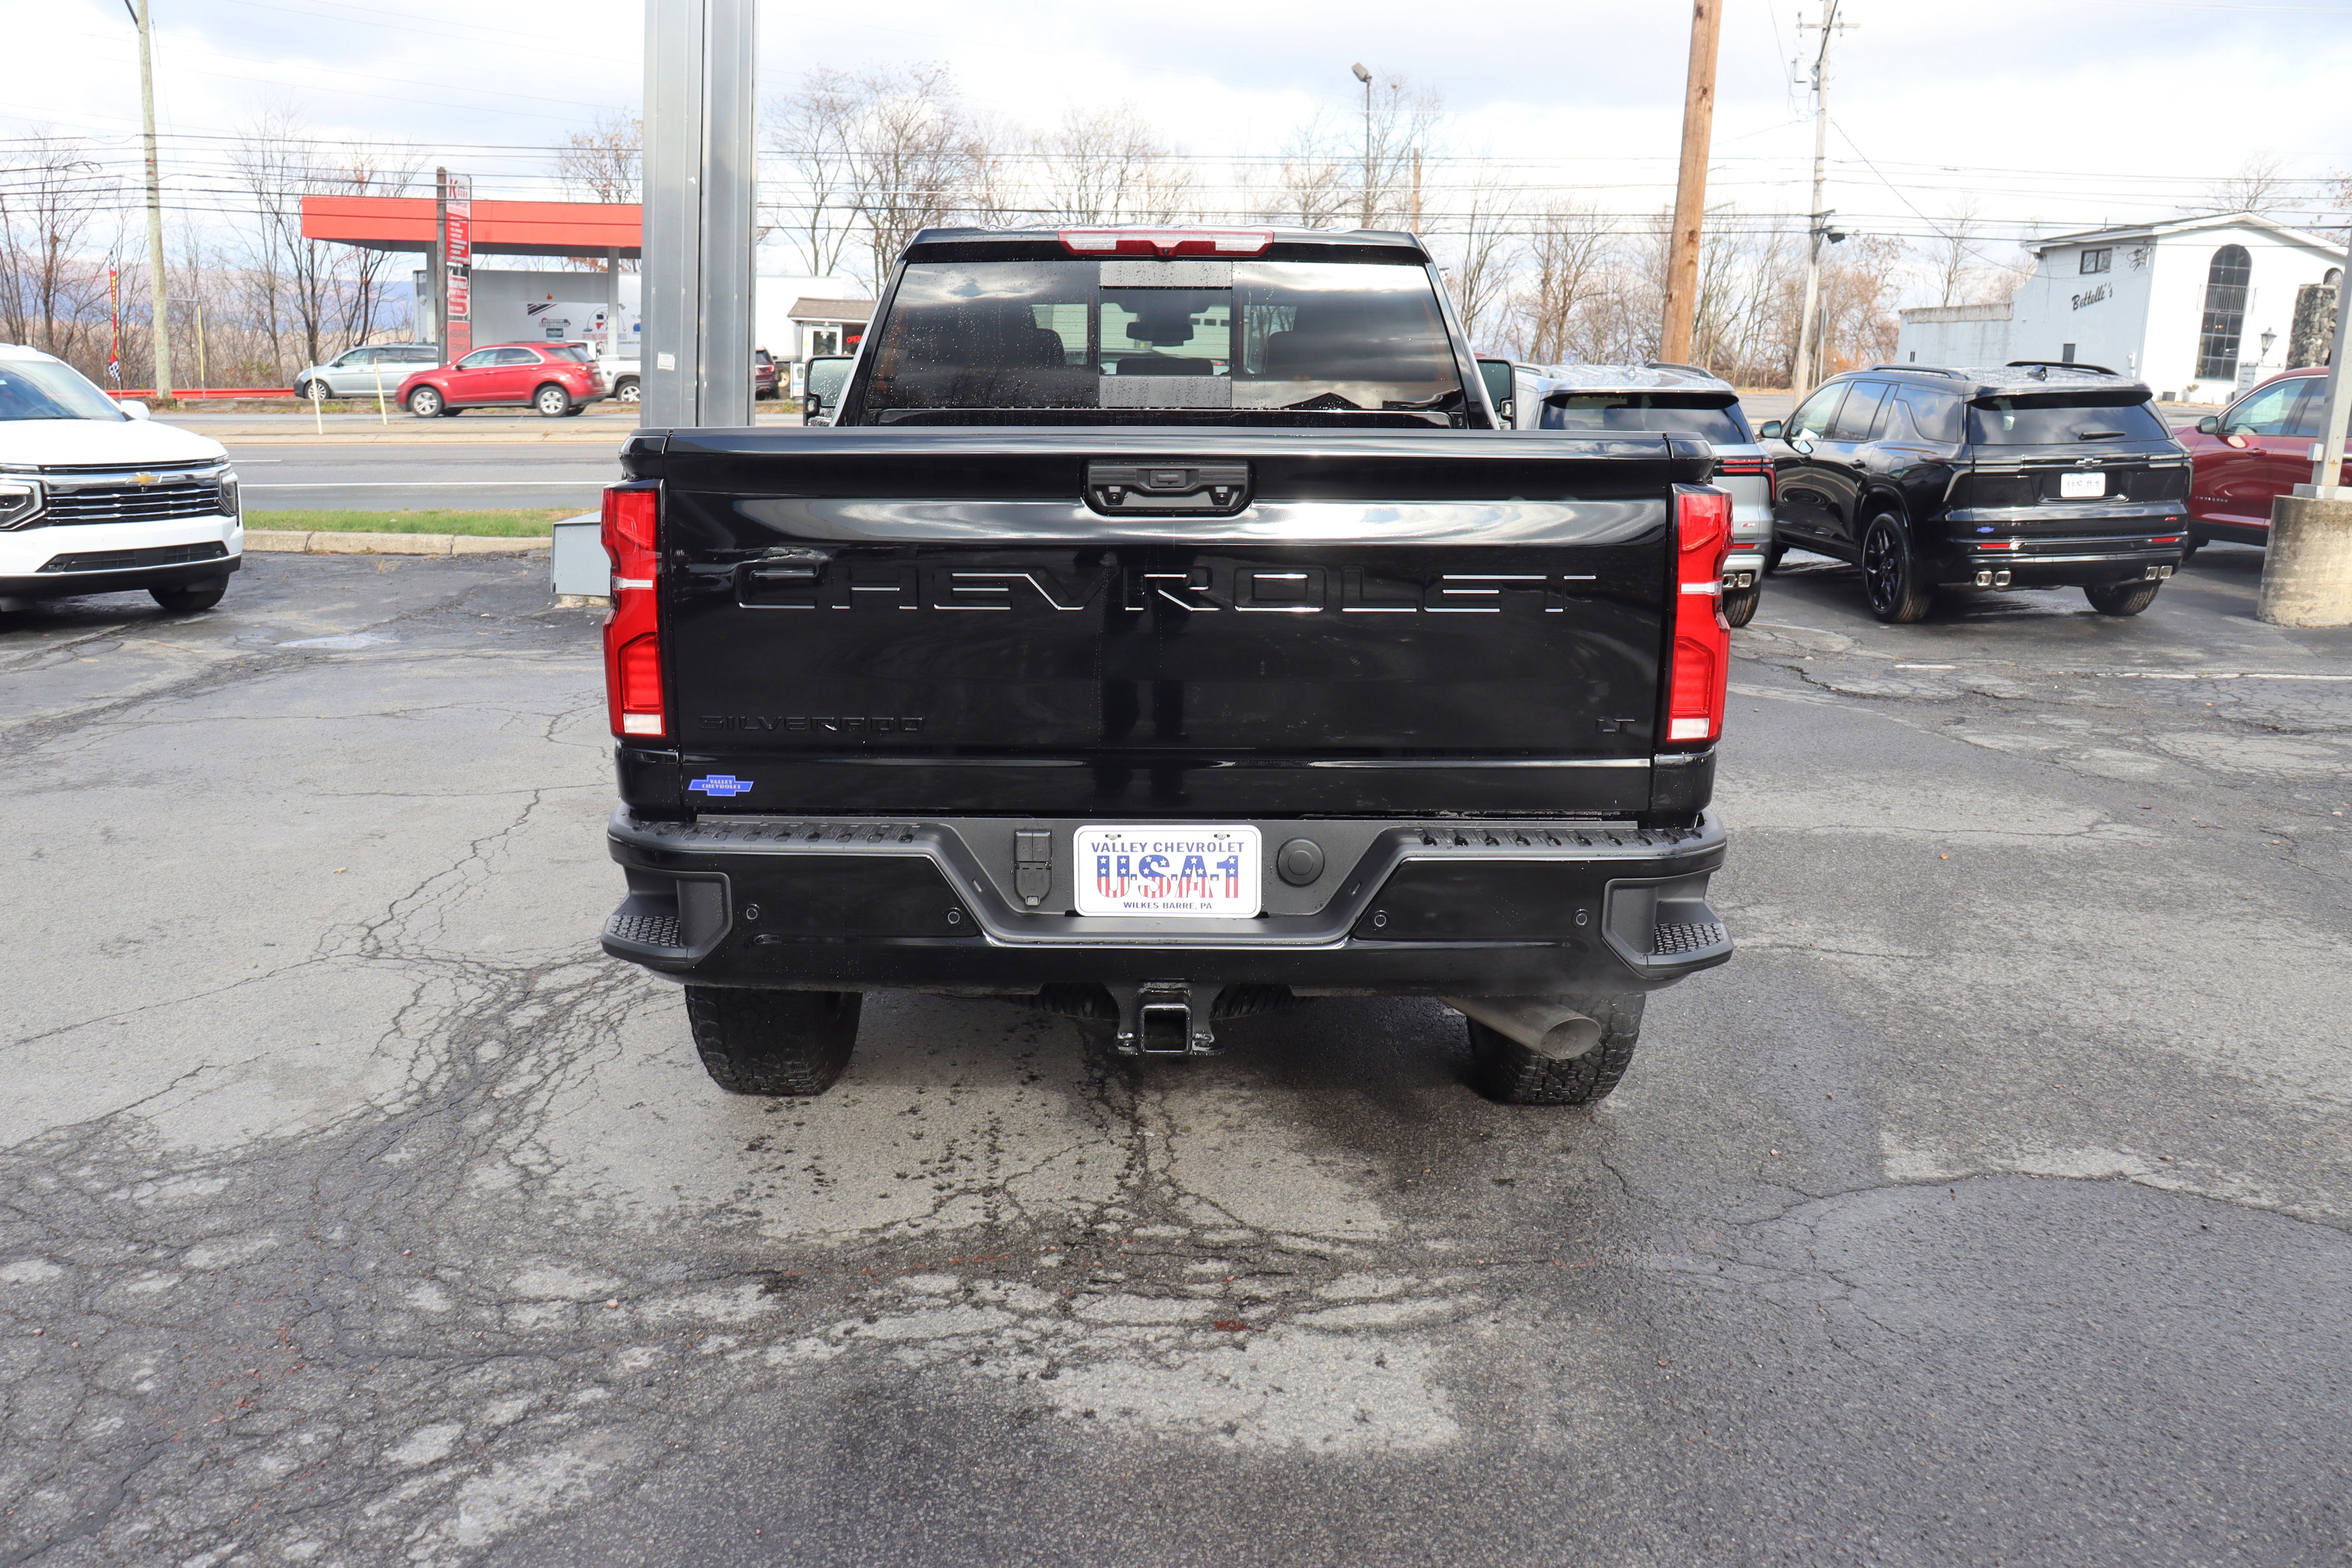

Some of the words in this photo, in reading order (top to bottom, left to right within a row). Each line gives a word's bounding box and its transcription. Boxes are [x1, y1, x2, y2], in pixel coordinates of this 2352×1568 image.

[735, 566, 1597, 612] CHEVROLET
[699, 715, 925, 732] SILVERADO
[1596, 718, 1635, 734] LT
[1091, 842, 1148, 853] VALLEY
[1153, 842, 1245, 853] CHEVROLET
[1123, 901, 1197, 911] WILKES-BARRE,
